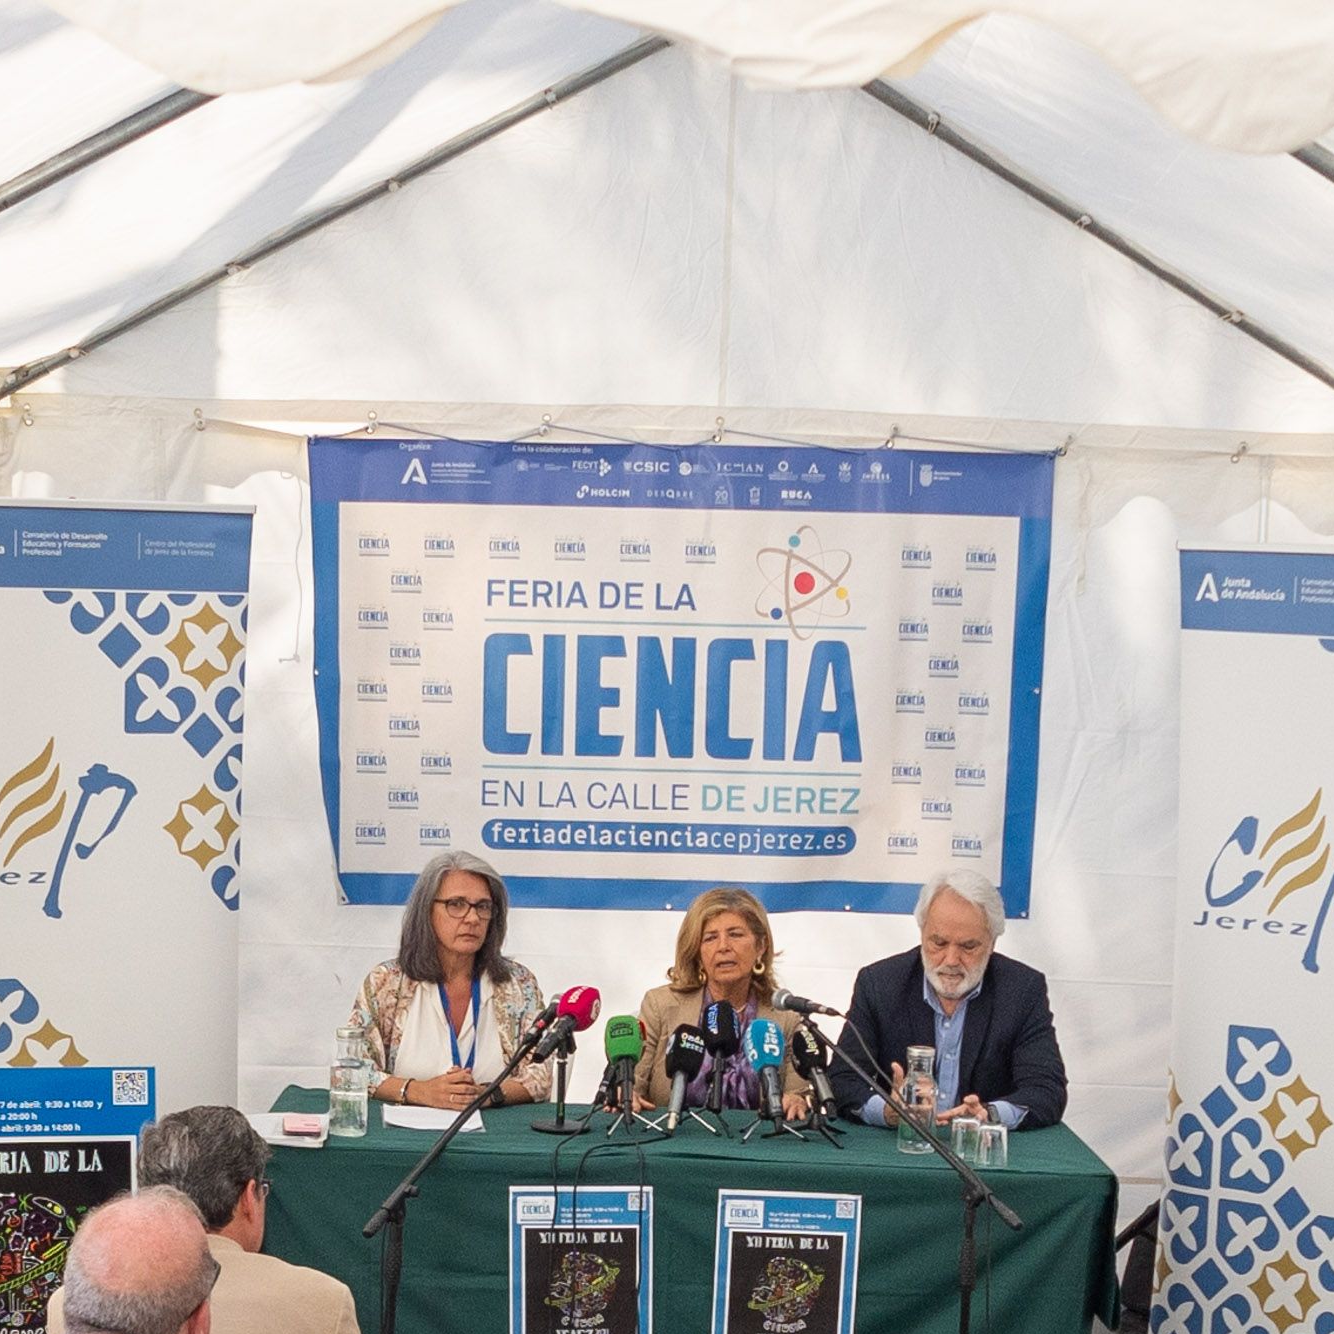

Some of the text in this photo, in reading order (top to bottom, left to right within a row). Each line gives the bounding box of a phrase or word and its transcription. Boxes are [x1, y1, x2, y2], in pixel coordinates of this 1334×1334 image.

[633, 461, 670, 473] CSIC
[359, 538, 390, 549] CIENCIA
[424, 540, 455, 550] CIENCIA
[489, 541, 520, 551] CIENCIA
[555, 543, 585, 553] CIENCIA
[620, 544, 651, 555] CIENCIA
[685, 545, 716, 556] CIENCIA
[902, 550, 932, 561] CIENCIA
[966, 552, 997, 563] CIENCIA
[391, 575, 422, 586] CIENCIA
[1222, 577, 1251, 588] Junta
[486, 579, 697, 611] FERIA DE LA
[932, 587, 963, 598] CIENCIA
[1221, 588, 1285, 601] de Andalucía
[358, 611, 389, 622] CIENCIA
[423, 613, 453, 623] CIENCIA
[899, 623, 929, 634] CIENCIA
[962, 625, 993, 636] CIENCIA
[390, 648, 421, 658] CIENCIA
[929, 660, 959, 670] CIENCIA
[357, 684, 388, 694] CIENCIA
[422, 685, 452, 695] CIENCIA
[482, 633, 863, 763] CIENCIA
[896, 695, 925, 706] CIENCIA
[958, 697, 989, 708] CIENCIA
[389, 720, 420, 730] CIENCIA
[925, 731, 956, 742] CIENCIA
[356, 756, 387, 766] CIENCIA
[421, 757, 452, 767] CIENCIA
[892, 767, 921, 777] CIENCIA
[955, 768, 986, 778] CIENCIA
[388, 792, 419, 802] CIENCIA
[481, 780, 861, 815] EN LA CALLE DE JEREZ
[921, 802, 953, 813] CIENCIA
[355, 827, 386, 837] CIENCIA
[420, 828, 451, 838] CIENCIA
[491, 822, 848, 853] feriadelacienciacepjerez.es
[888, 837, 918, 847] CIENCIA
[952, 839, 982, 850] CIENCIA
[1193, 911, 1309, 936] Jerez
[681, 1032, 705, 1046] Onda
[7, 1101, 17, 1109] de
[96, 1101, 103, 1109] y
[31, 1112, 38, 1120] h
[75, 1123, 81, 1131] h
[44, 1150, 70, 1173] DE
[78, 1149, 103, 1172] LA
[730, 1208, 759, 1218] CIENCIA
[593, 1232, 607, 1244] DE
[610, 1232, 623, 1243] LA
[746, 1236, 829, 1250] XII FERIA DE LA
